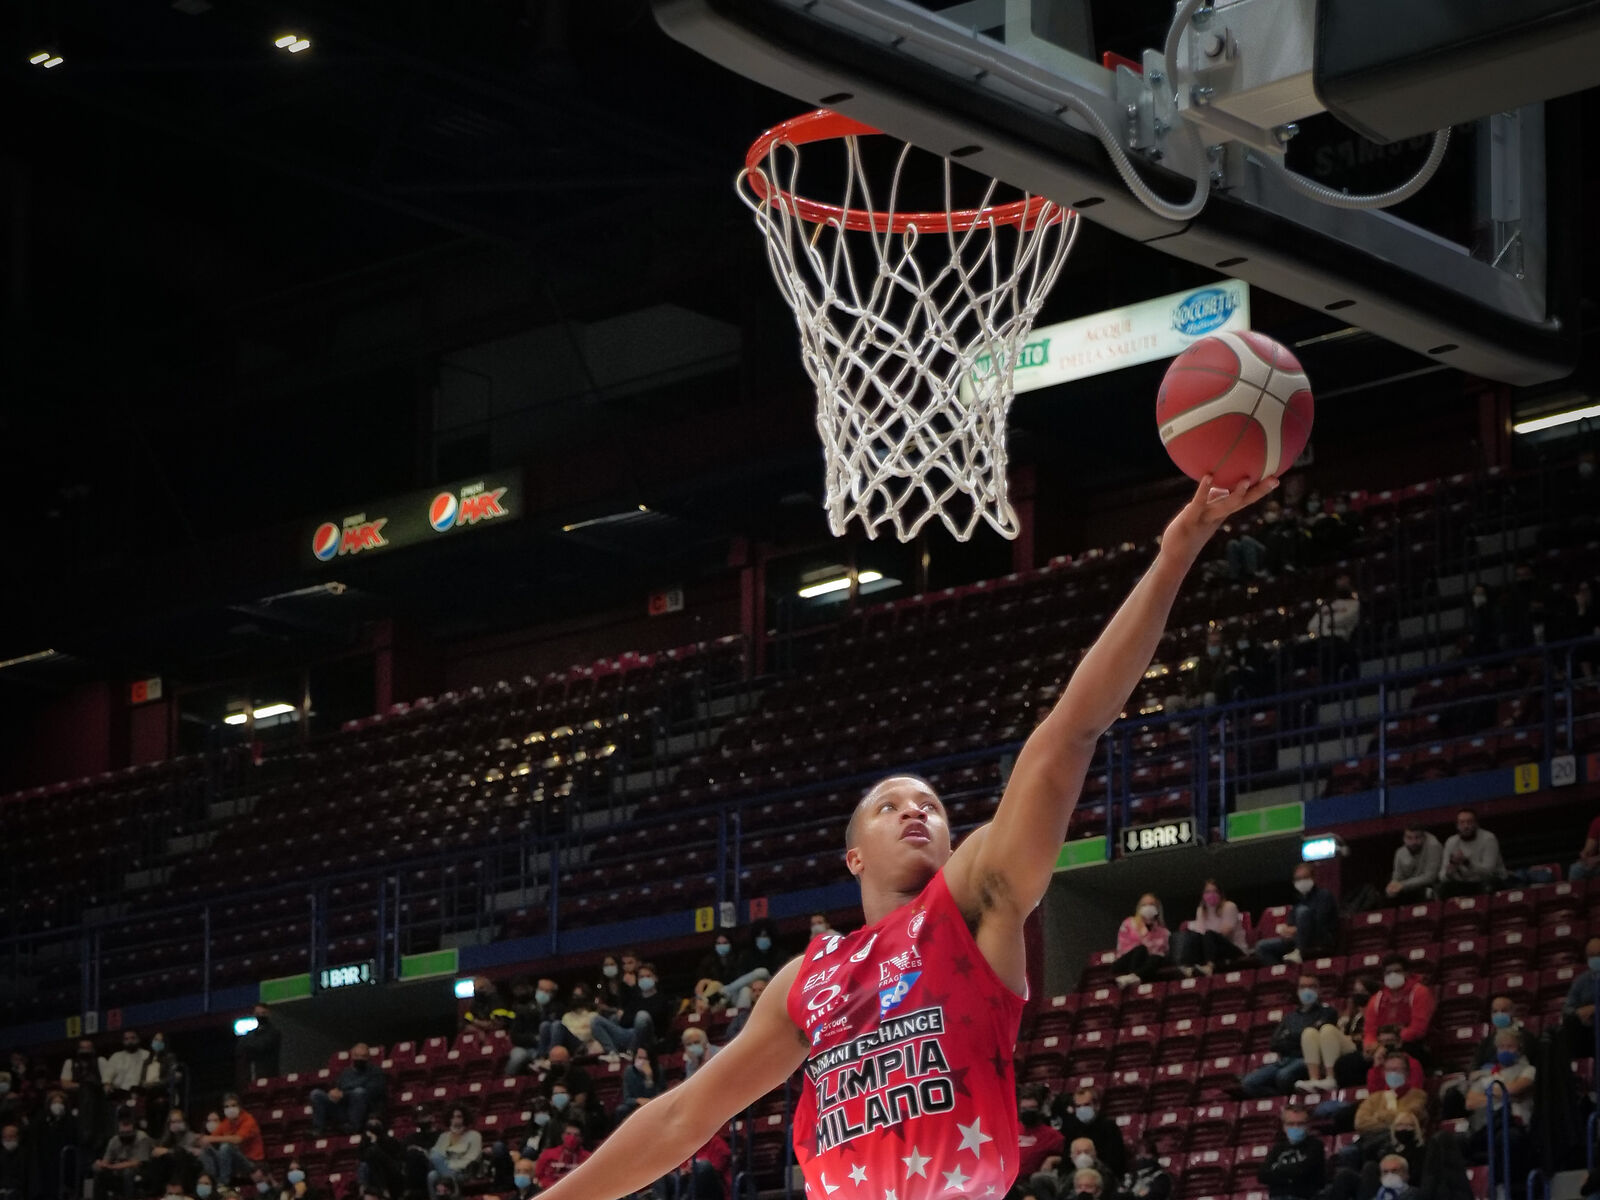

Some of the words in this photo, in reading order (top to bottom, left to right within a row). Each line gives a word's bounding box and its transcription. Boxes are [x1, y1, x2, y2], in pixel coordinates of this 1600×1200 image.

[1139, 825, 1178, 850] BAR
[329, 965, 360, 988] BAR
[815, 1077, 956, 1157] MILANO
